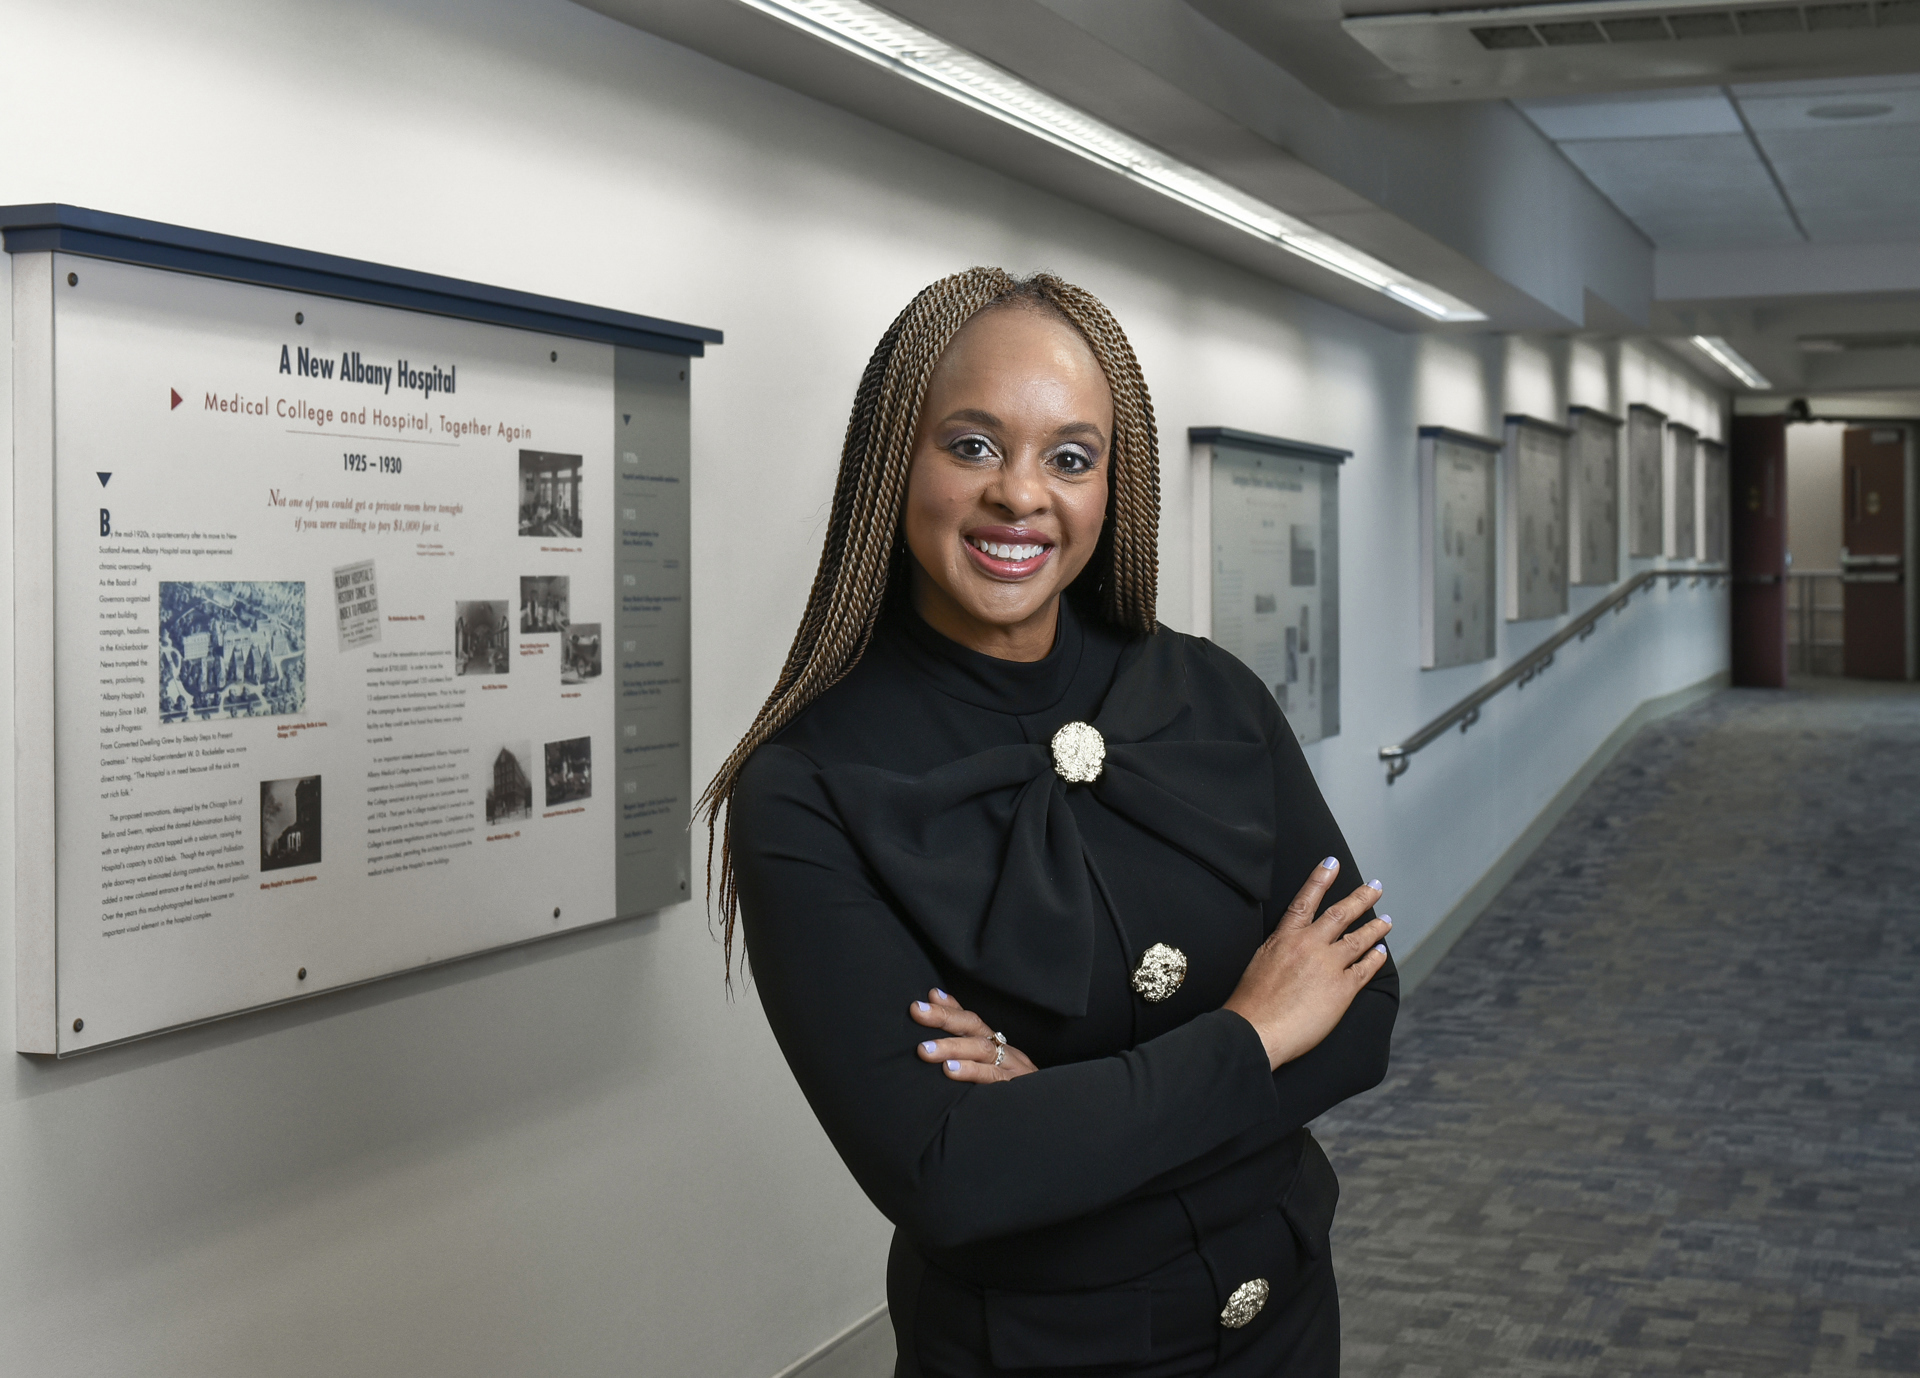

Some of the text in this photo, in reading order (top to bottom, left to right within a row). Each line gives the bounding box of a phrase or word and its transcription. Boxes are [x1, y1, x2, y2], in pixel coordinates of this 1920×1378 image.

[279, 344, 456, 399] A New Albany Hospital
[205, 392, 532, 442] Medical College and Hospital, Together Again
[268, 489, 286, 507] Not
[305, 496, 314, 511] of
[316, 500, 329, 511] you
[332, 498, 353, 509] could
[355, 501, 366, 513] get
[376, 500, 401, 514] private
[404, 504, 420, 512] room
[439, 503, 463, 516] tonight
[303, 520, 317, 532] you
[320, 520, 336, 528] were
[339, 518, 366, 532] willing
[142, 547, 158, 555] Albany
